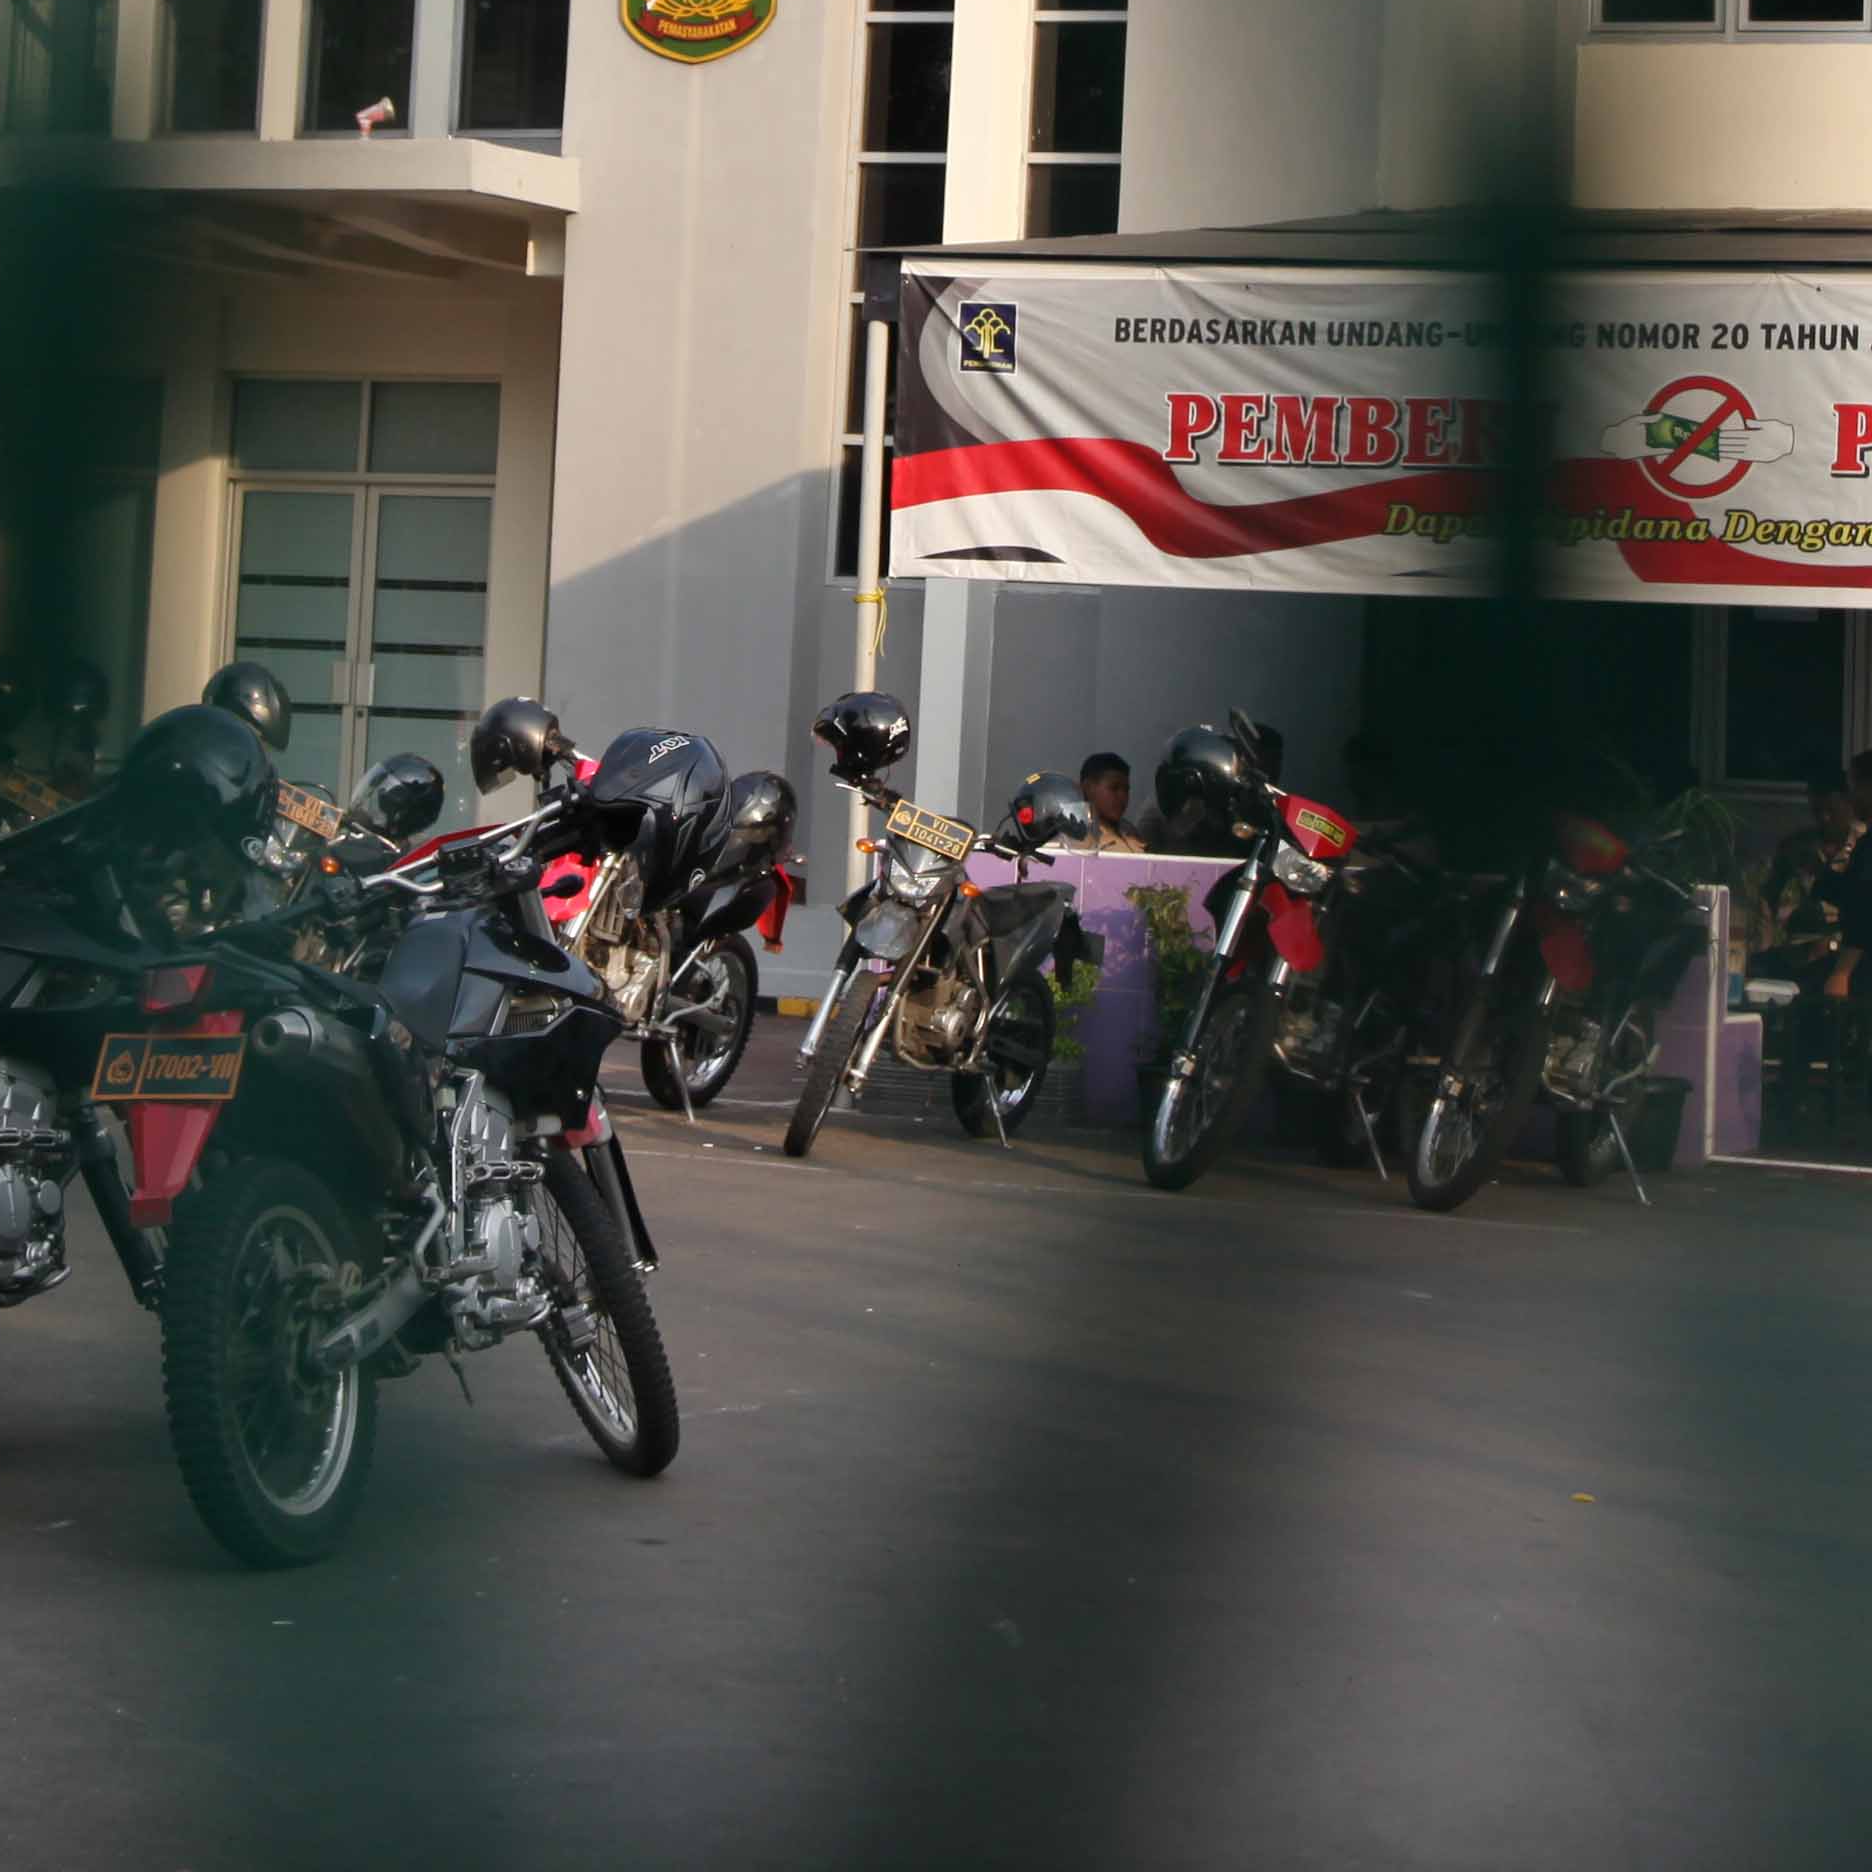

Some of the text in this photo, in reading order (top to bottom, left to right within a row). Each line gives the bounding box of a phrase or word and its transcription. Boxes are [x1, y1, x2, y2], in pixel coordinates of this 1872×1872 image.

[1114, 317, 1316, 346] BERDASARKAN
[1595, 322, 1700, 350] NOMOR
[1711, 322, 1749, 350] 20
[1762, 323, 1860, 352] TAHUN
